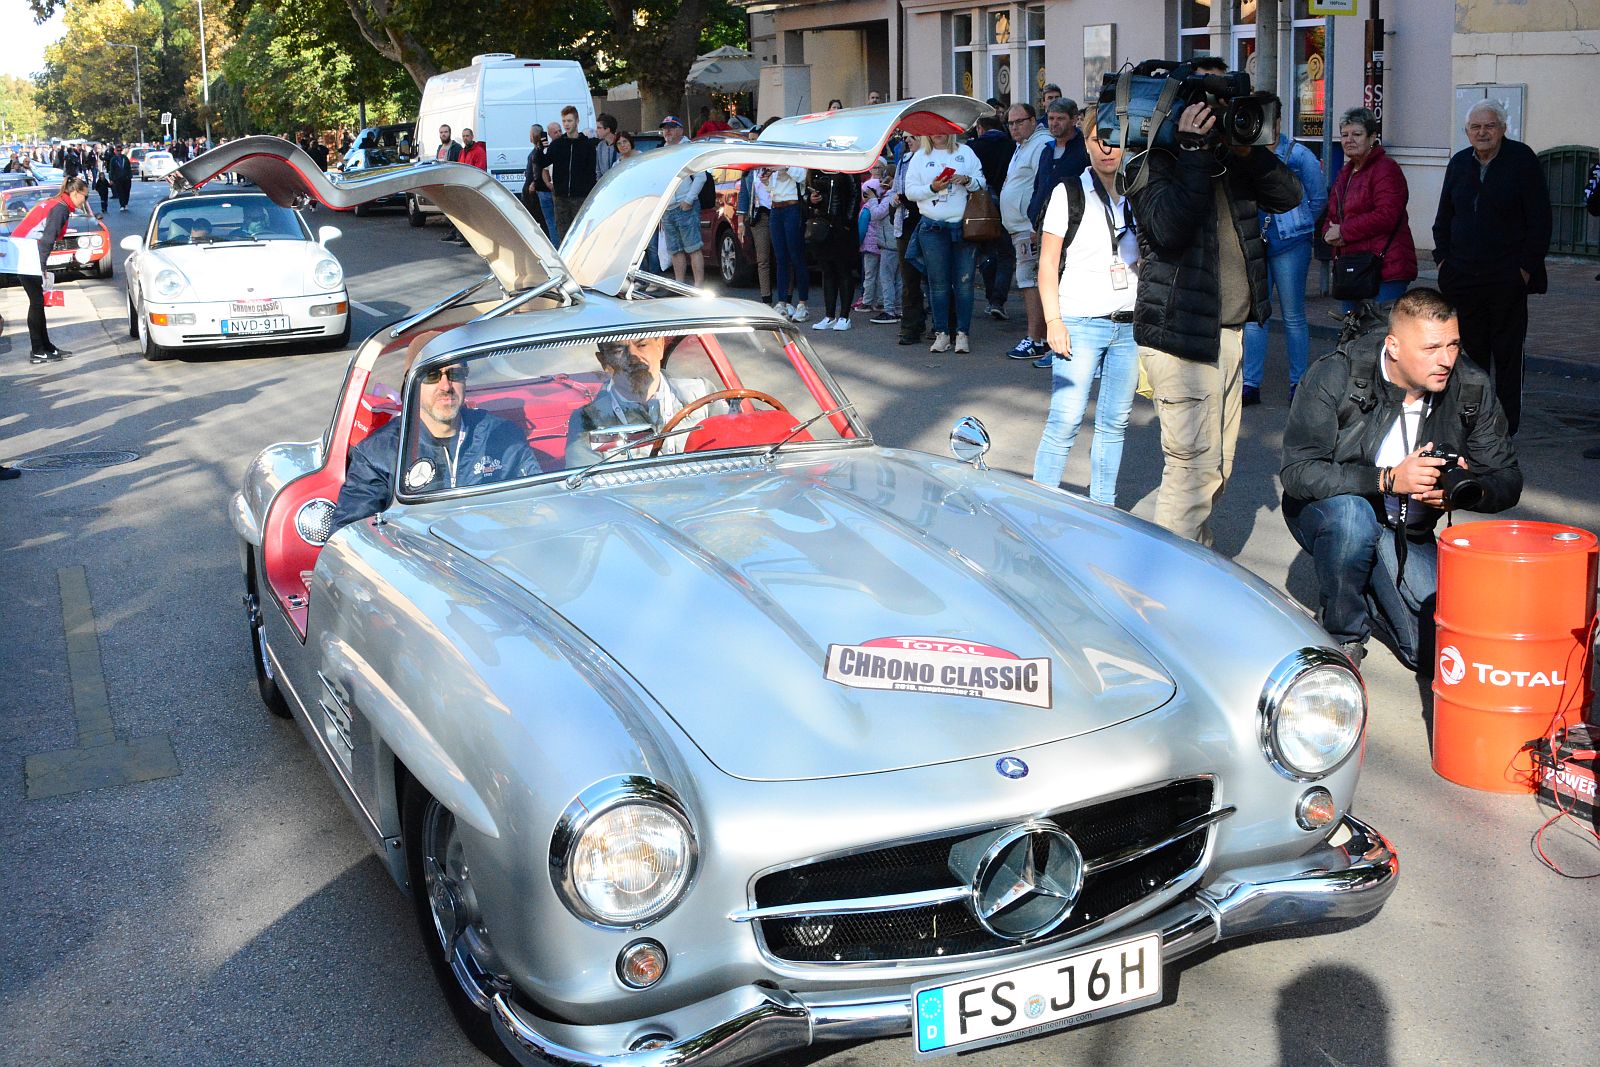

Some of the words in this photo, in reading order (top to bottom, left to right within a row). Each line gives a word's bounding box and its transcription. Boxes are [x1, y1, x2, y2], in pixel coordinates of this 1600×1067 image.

[232, 303, 256, 313] CHRONO
[256, 300, 280, 313] CLASSIC
[231, 318, 285, 332] NVD-911
[838, 647, 935, 685] CHRONO
[940, 662, 1039, 693] CLASSIC
[1545, 766, 1598, 798] POWER
[958, 980, 1017, 1035] FS
[1050, 946, 1145, 1012] J6H
[926, 1024, 938, 1040] D
